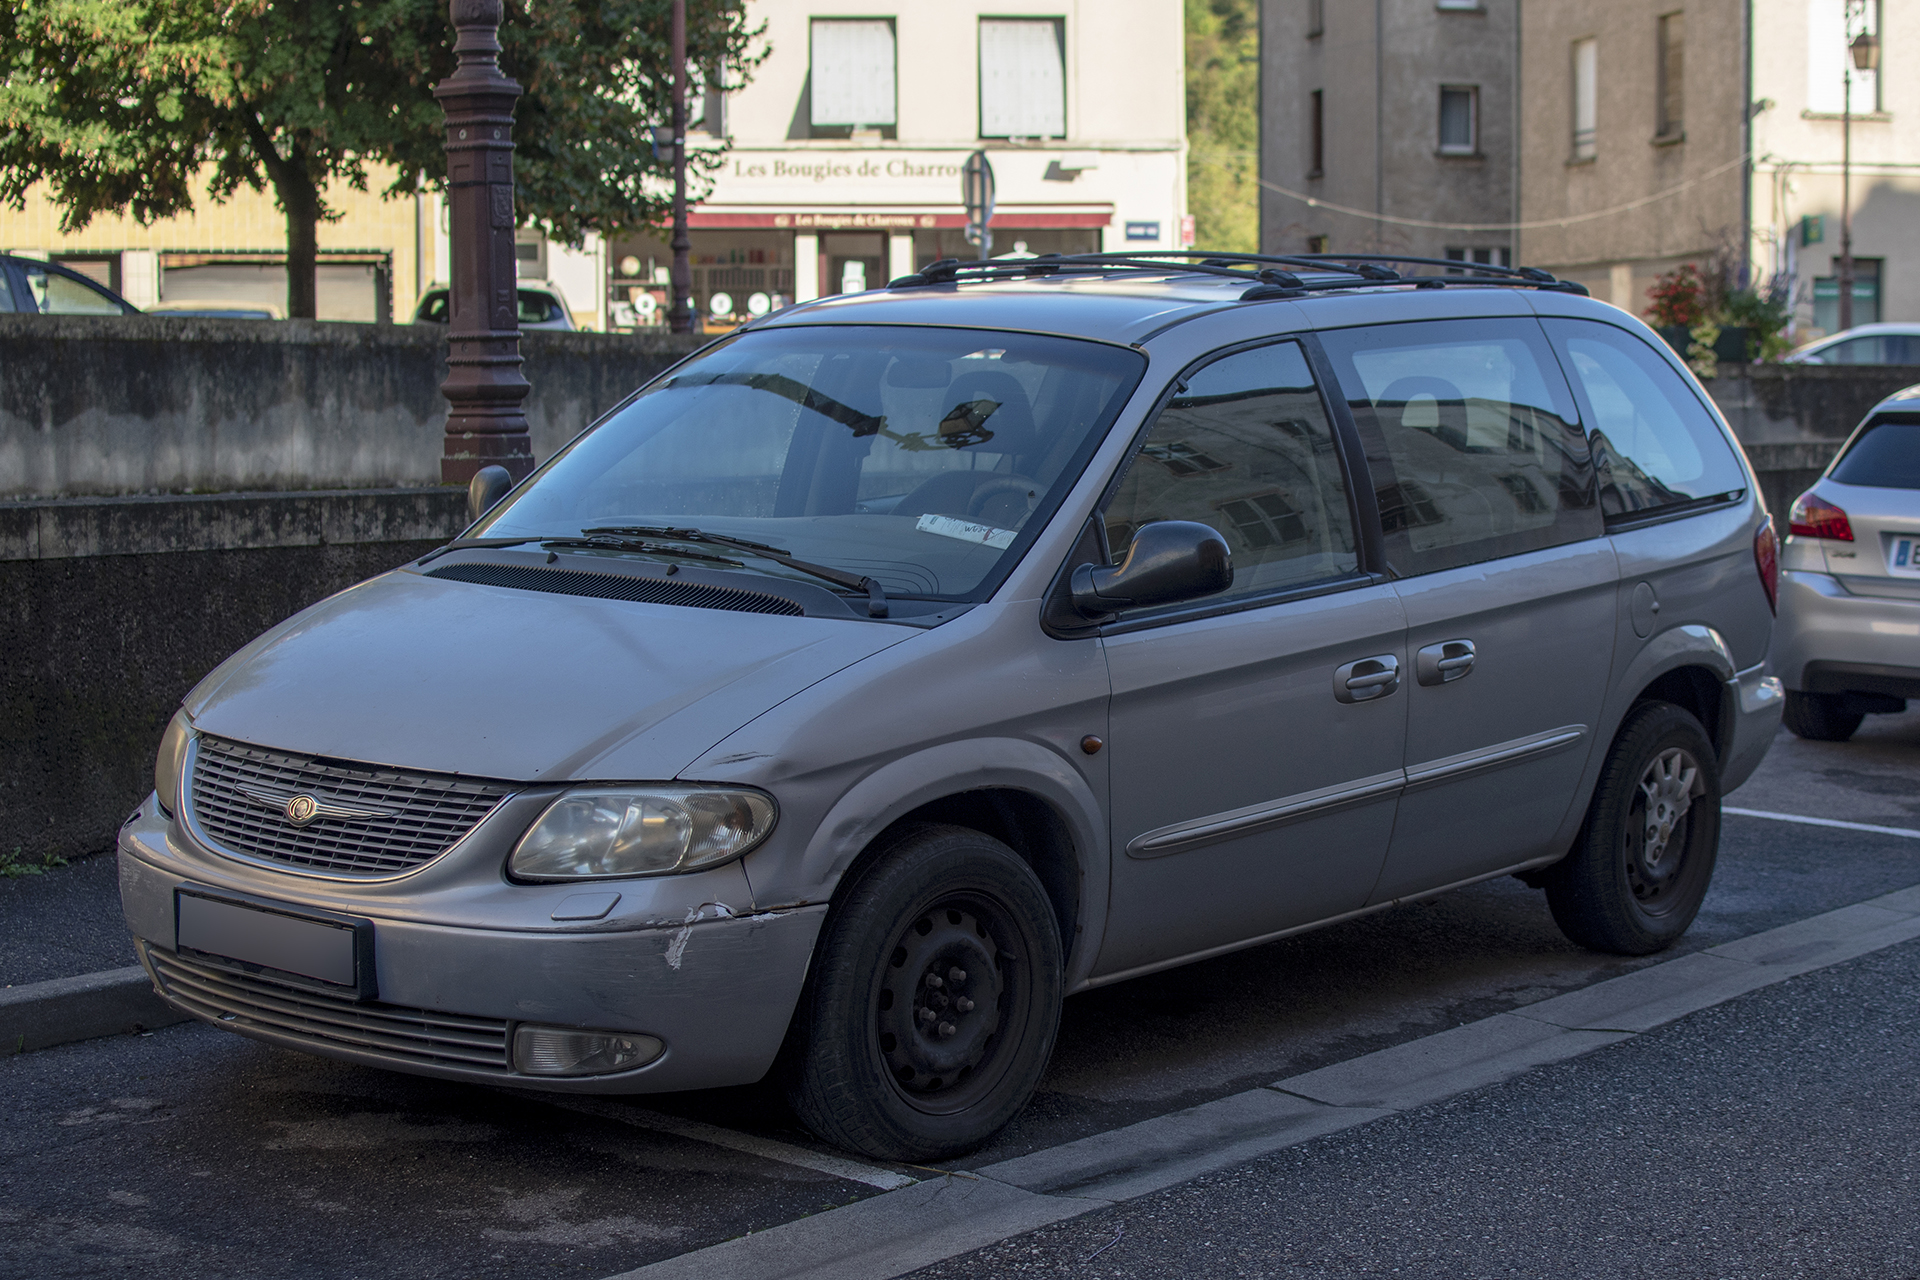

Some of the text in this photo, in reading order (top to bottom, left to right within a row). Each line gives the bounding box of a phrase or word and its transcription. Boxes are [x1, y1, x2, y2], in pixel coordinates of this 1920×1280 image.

[734, 159, 964, 183] Les Bougies de Charro
[795, 213, 812, 227] Les
[813, 213, 851, 229] Bougies
[853, 213, 866, 227] de
